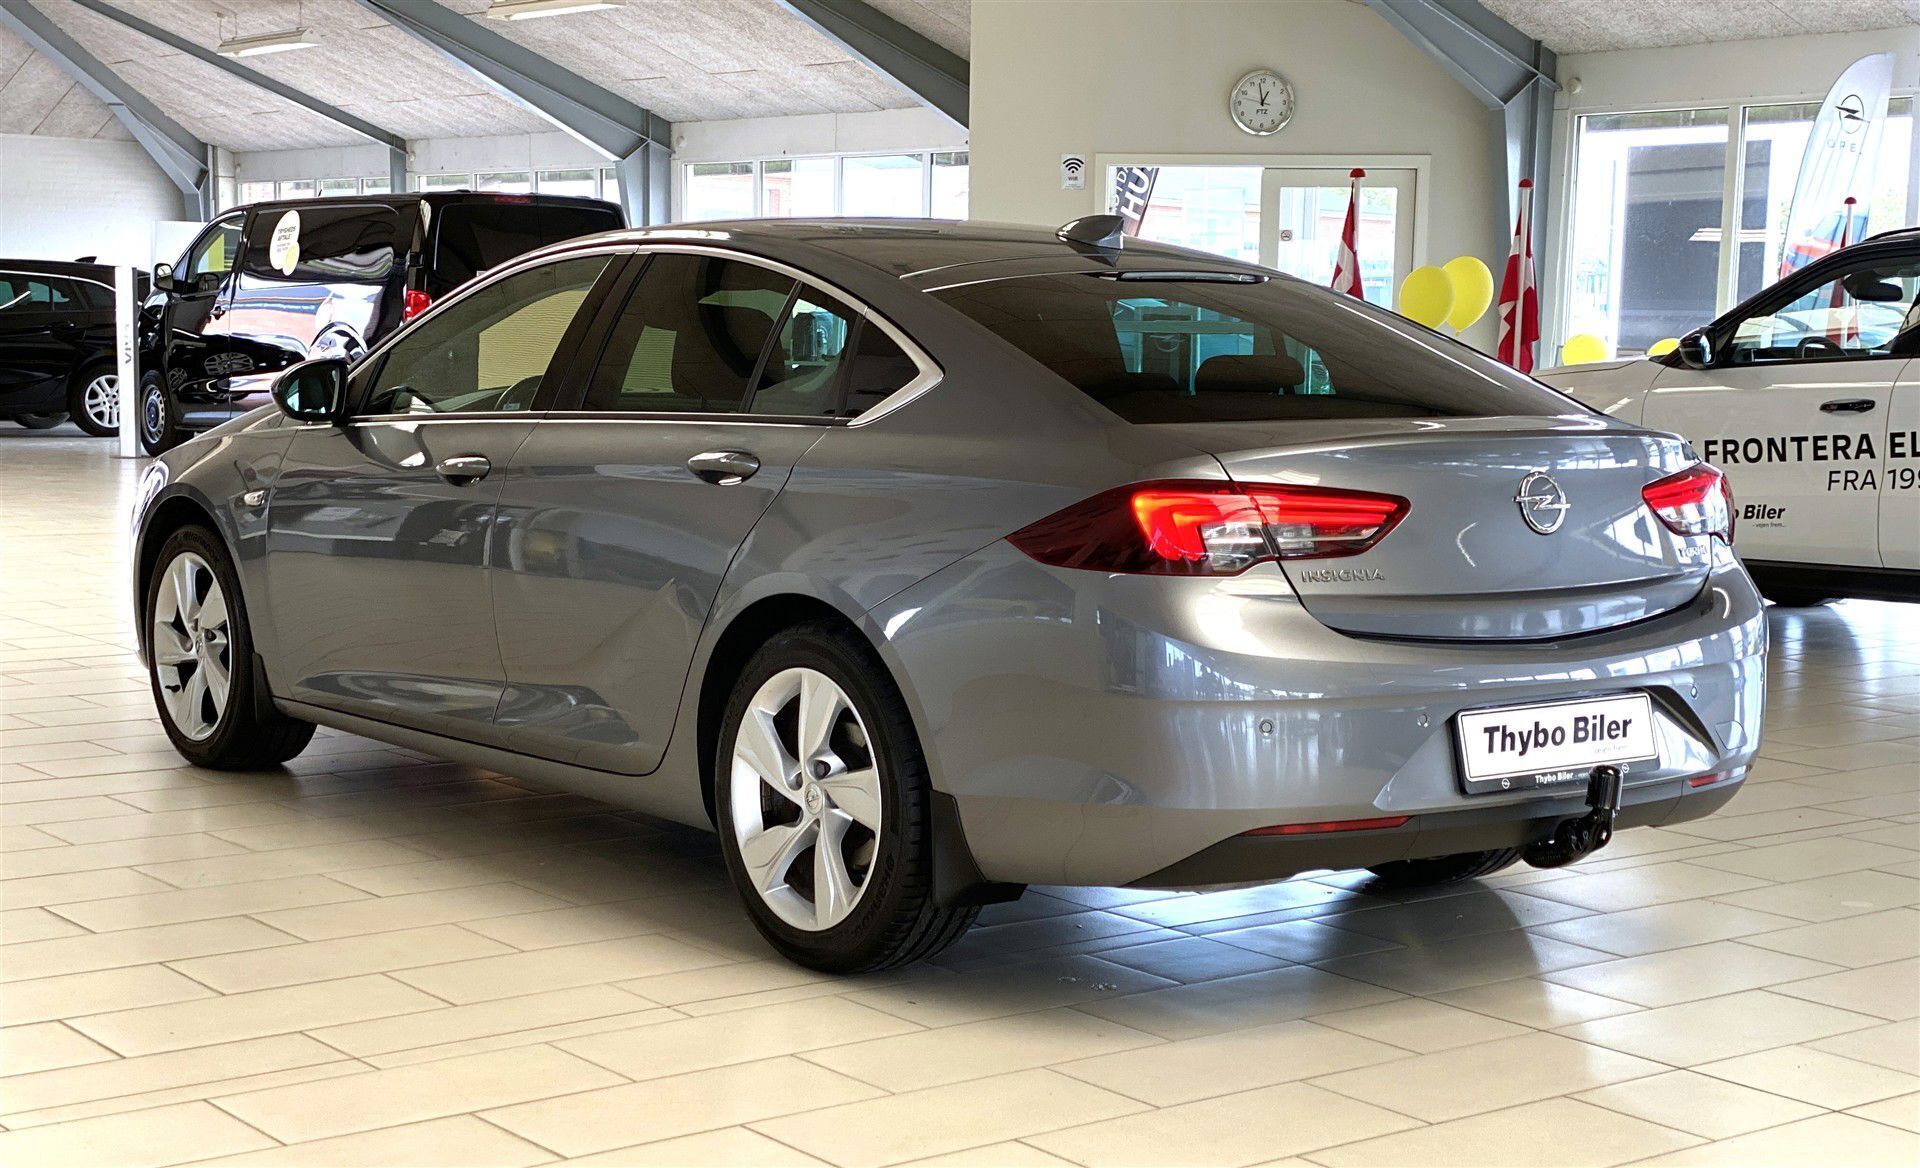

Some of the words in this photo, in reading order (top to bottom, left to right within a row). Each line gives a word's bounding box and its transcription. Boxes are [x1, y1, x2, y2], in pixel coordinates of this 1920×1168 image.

[1704, 433, 1876, 464] FRONTERA
[1827, 469, 1877, 491] FRA
[1887, 467, 1920, 490] 19
[1743, 504, 1786, 519] Biler
[1301, 568, 1385, 583] INSIGNIA
[1483, 721, 1566, 757] Thybo
[1573, 714, 1632, 743] Biler
[1535, 773, 1556, 784] Thybo
[1557, 771, 1574, 781] Biler
